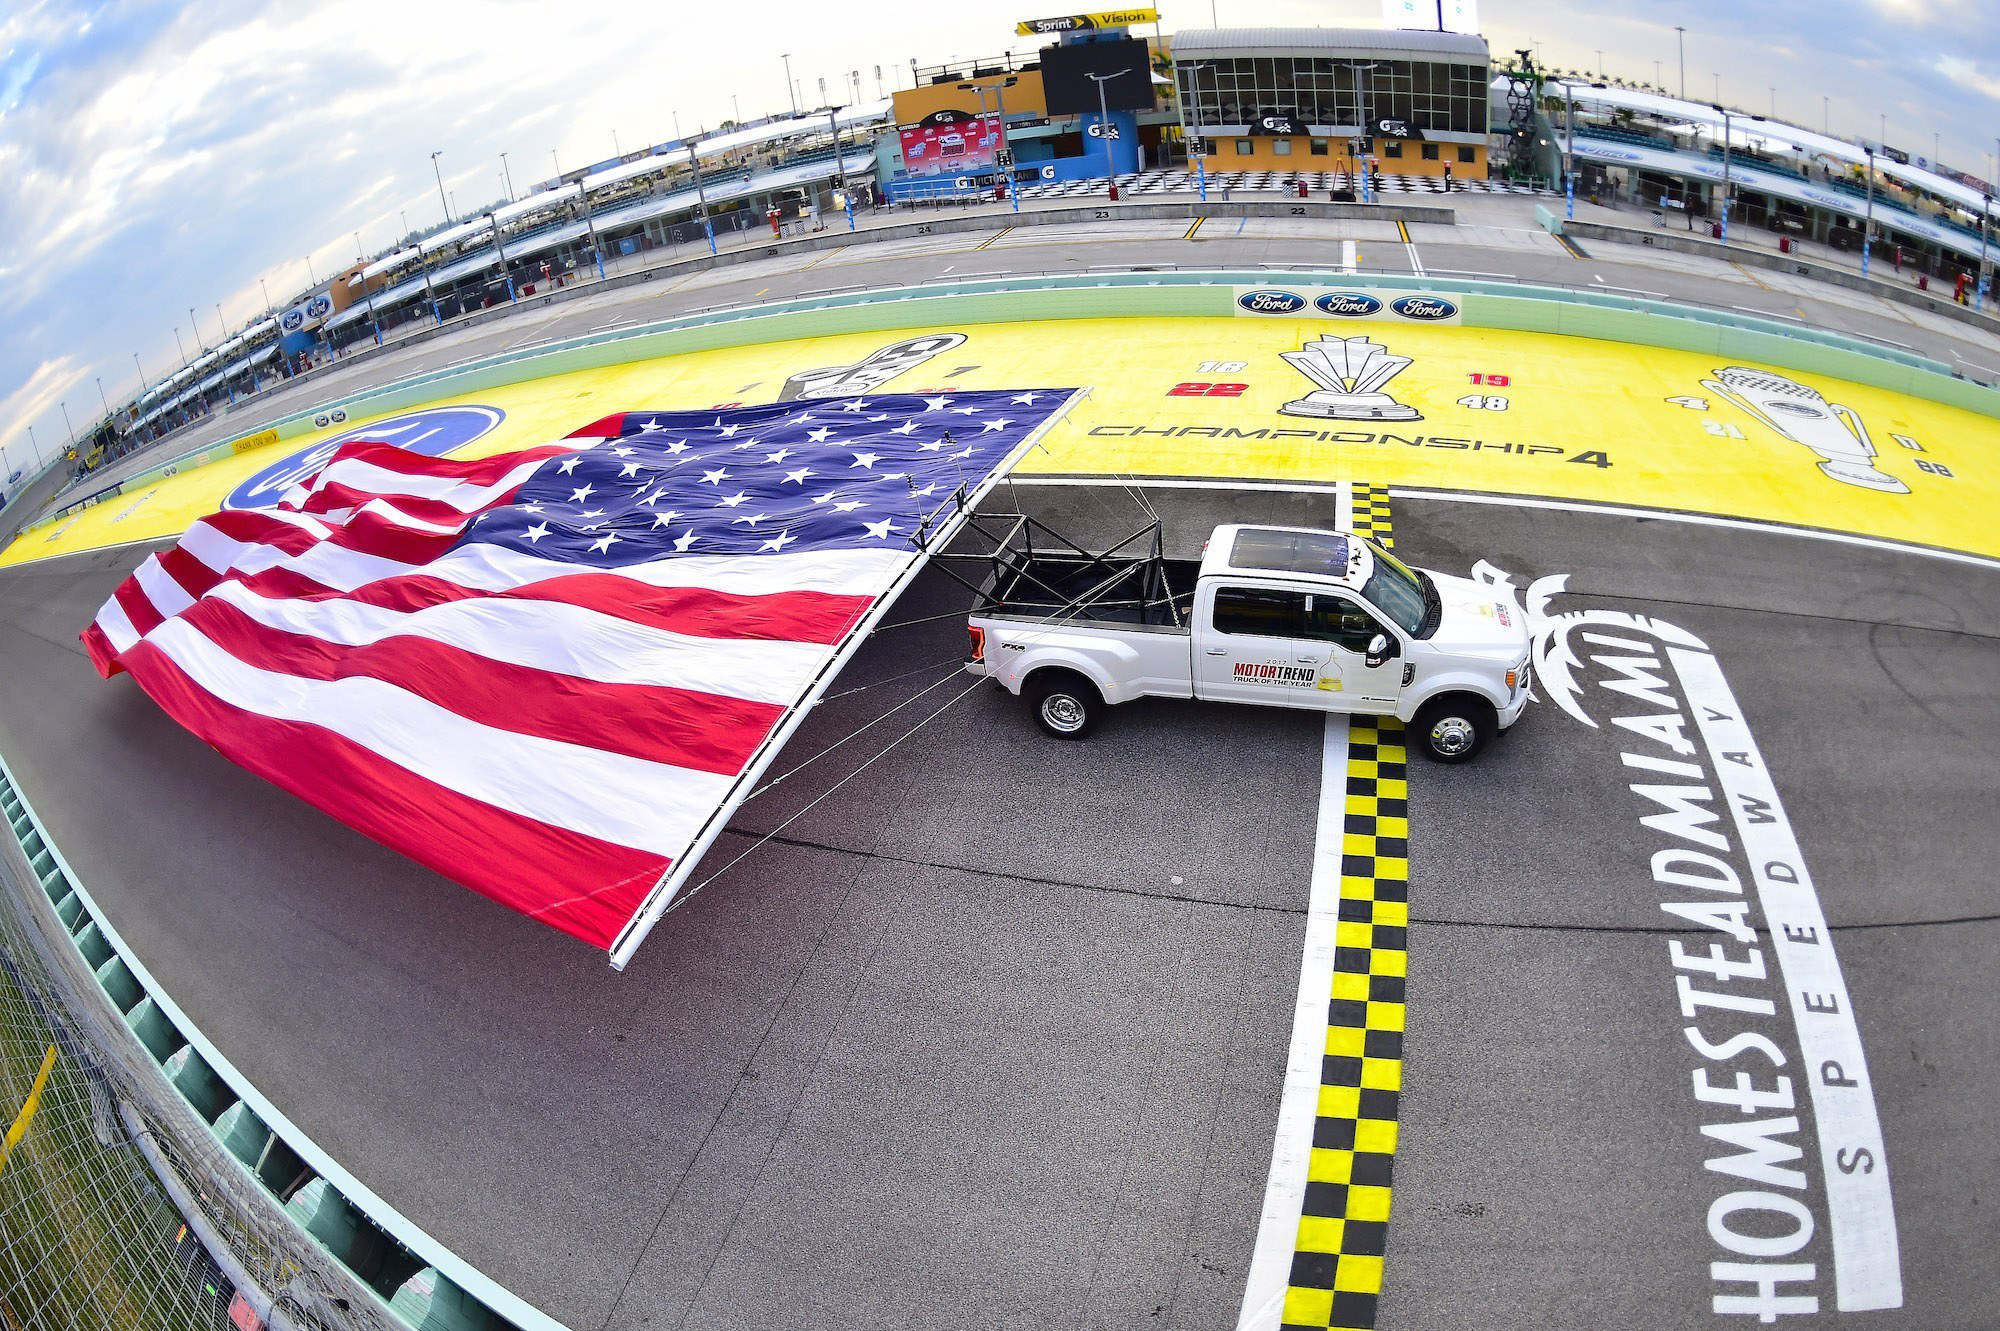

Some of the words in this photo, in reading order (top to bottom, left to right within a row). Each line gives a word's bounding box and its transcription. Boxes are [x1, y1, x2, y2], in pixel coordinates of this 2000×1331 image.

[1036, 18, 1072, 32] Sprint
[1102, 12, 1146, 24] Vision
[1262, 117, 1274, 129] G
[1379, 119, 1391, 131] G
[1088, 124, 1100, 137] G
[955, 175, 967, 189] G
[976, 173, 1010, 188] VICTRY
[1041, 165, 1055, 179] G
[1095, 211, 1110, 219] 23
[1291, 207, 1306, 215] 22
[918, 226, 932, 234] 24
[1642, 236, 1654, 244] 21
[1796, 266, 1809, 275] 20
[1252, 293, 1294, 310] Ford
[1327, 296, 1369, 313] Ford
[1403, 298, 1446, 317] Ford
[286, 313, 301, 329] Ford
[1196, 361, 1248, 373] 18
[1466, 373, 1511, 387] 19
[1165, 382, 1249, 397] 22
[1456, 394, 1509, 411] 48
[1664, 395, 1710, 411] 4
[1702, 418, 1749, 441] 21
[1087, 425, 1565, 456] CHAMPIONSHIP
[1565, 450, 1614, 469] 4
[1913, 457, 1955, 478] 88
[1233, 676, 1259, 684] TRUCK
[1290, 680, 1312, 688] YEAR
[1702, 705, 1875, 1176] SPEEDWAY
